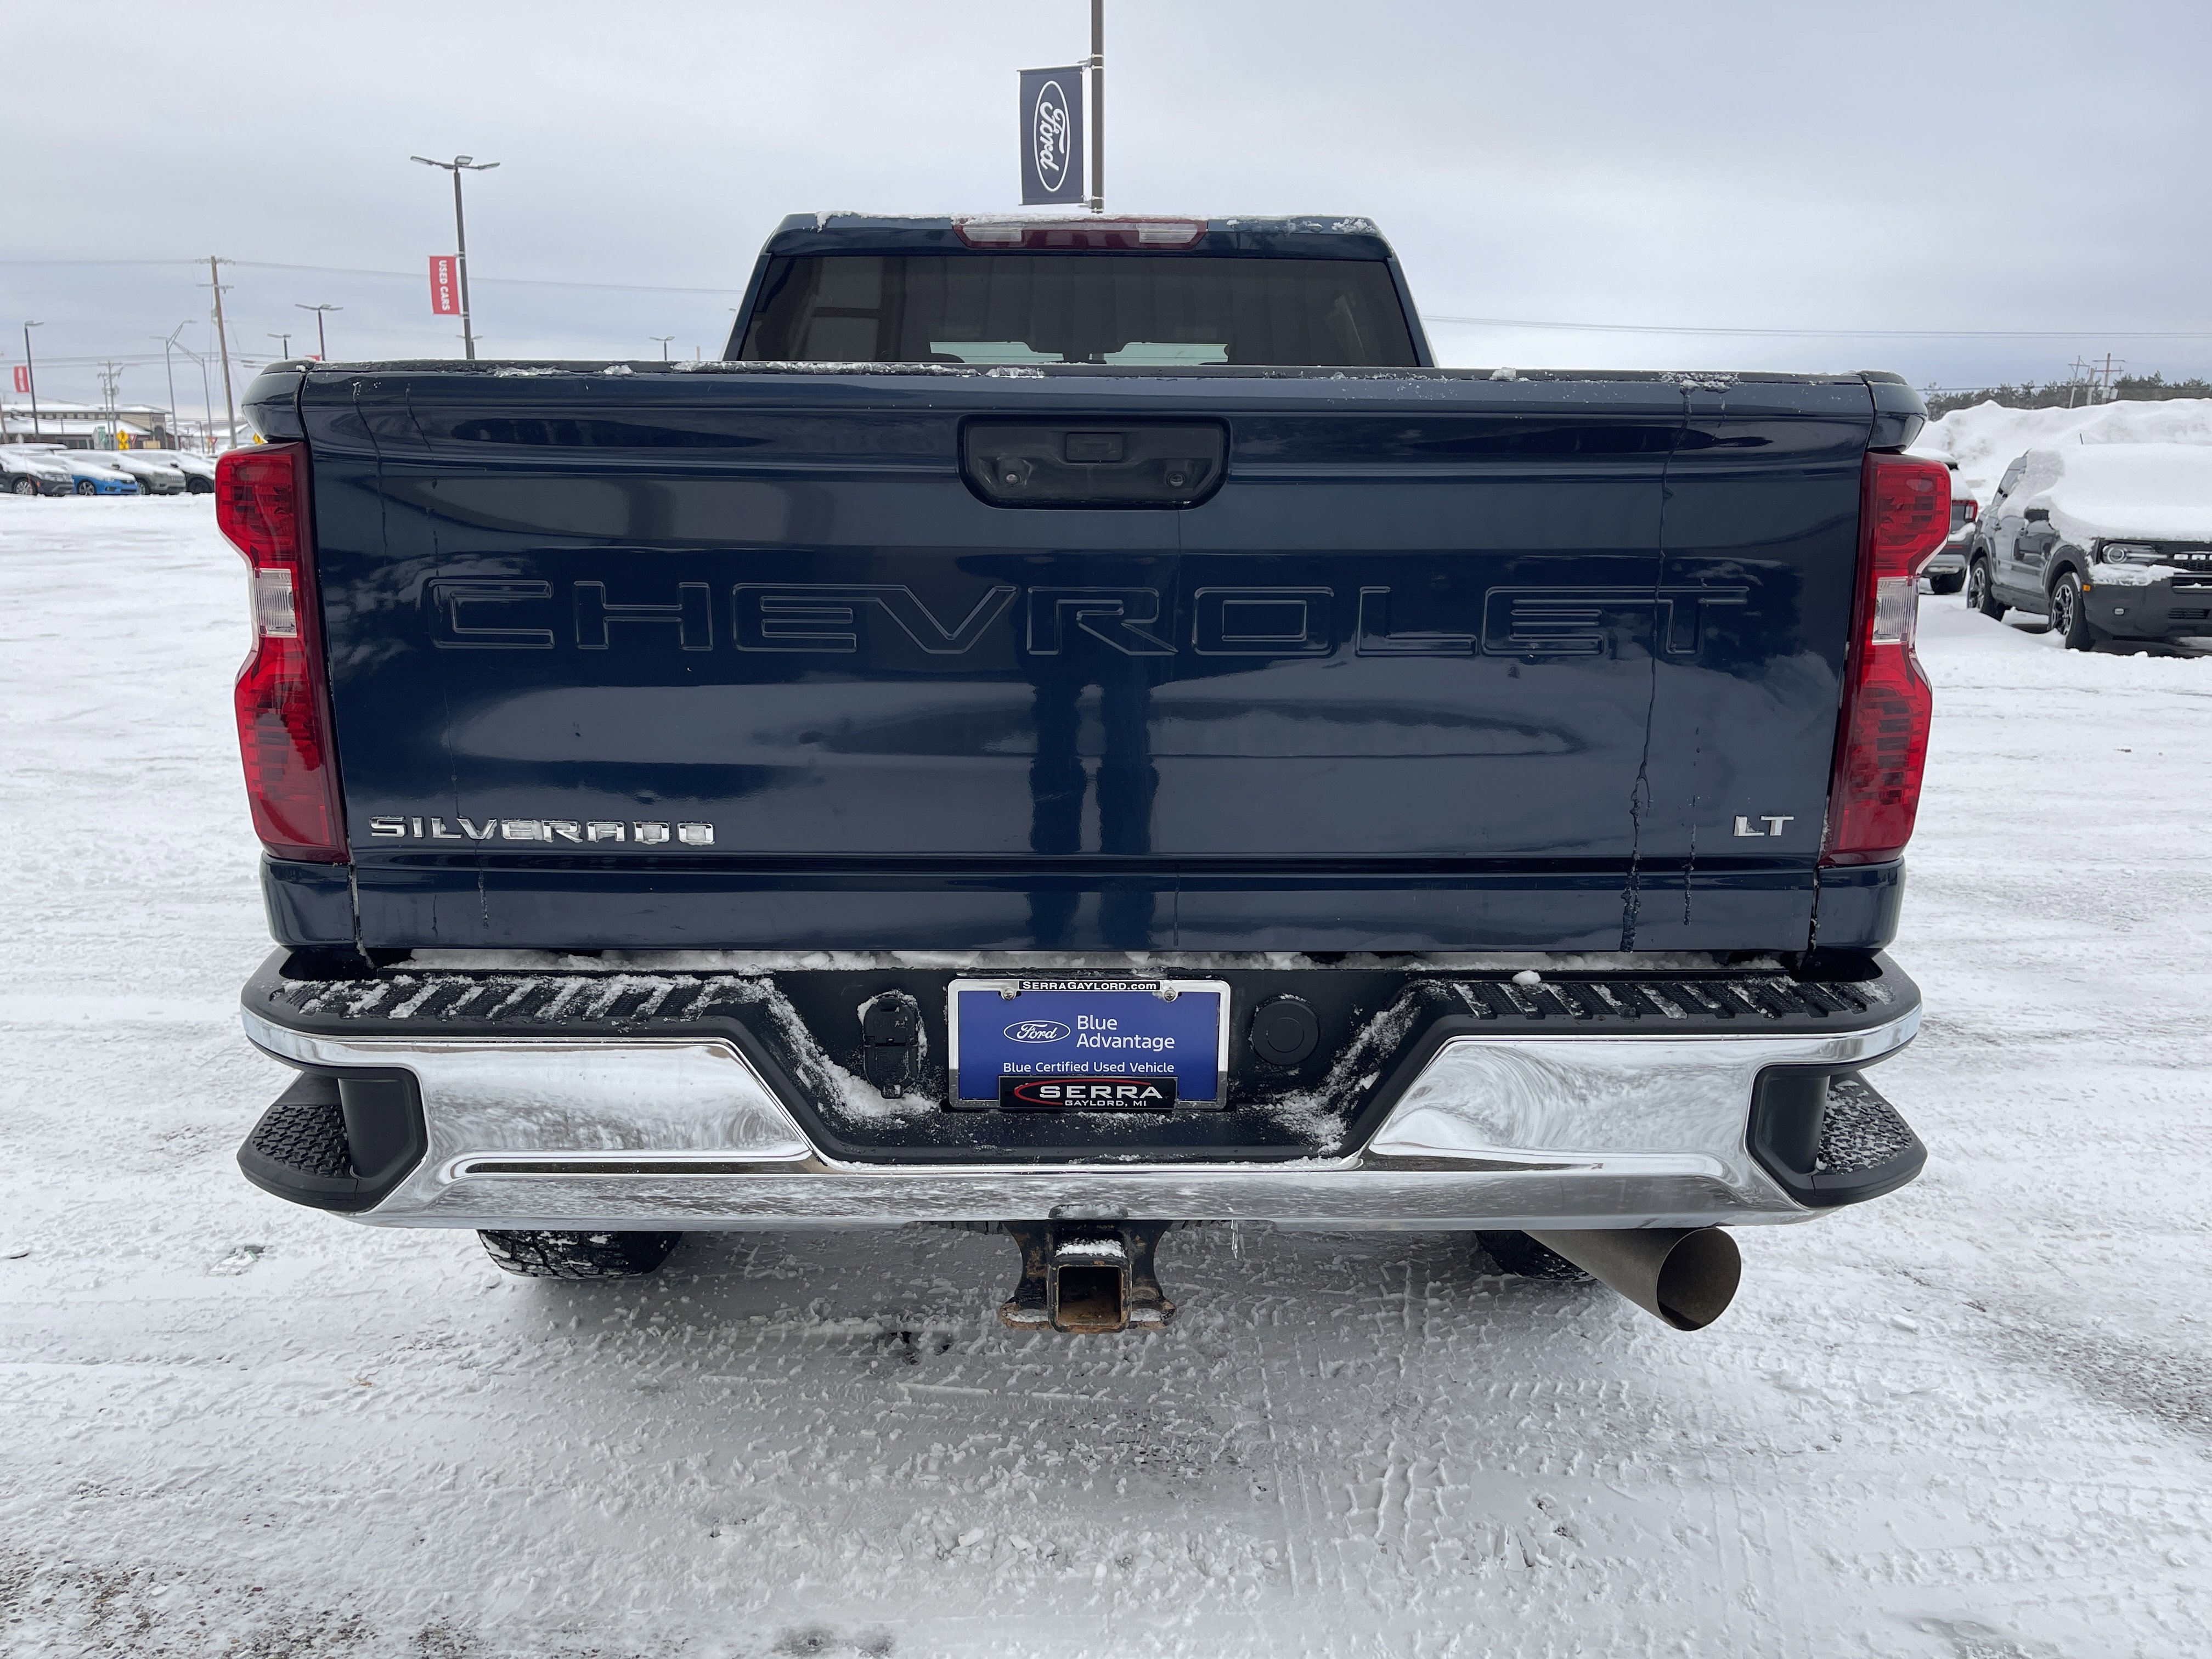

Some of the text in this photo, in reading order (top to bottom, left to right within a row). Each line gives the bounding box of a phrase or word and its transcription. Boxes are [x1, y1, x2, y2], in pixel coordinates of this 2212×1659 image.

[1040, 101, 1066, 171] Ford
[439, 259, 450, 311] USED CARS
[428, 579, 1750, 657] CHEVROLET
[370, 816, 715, 845] SILVERADO
[1734, 815, 1795, 837] LT
[1016, 1023, 1058, 1040] Ford
[1076, 1014, 1118, 1030] Blue
[1076, 1032, 1176, 1052] Advantage
[1003, 1062, 1175, 1073] Blue Certified Used Vehicle
[1039, 1085, 1163, 1099] SERRA
